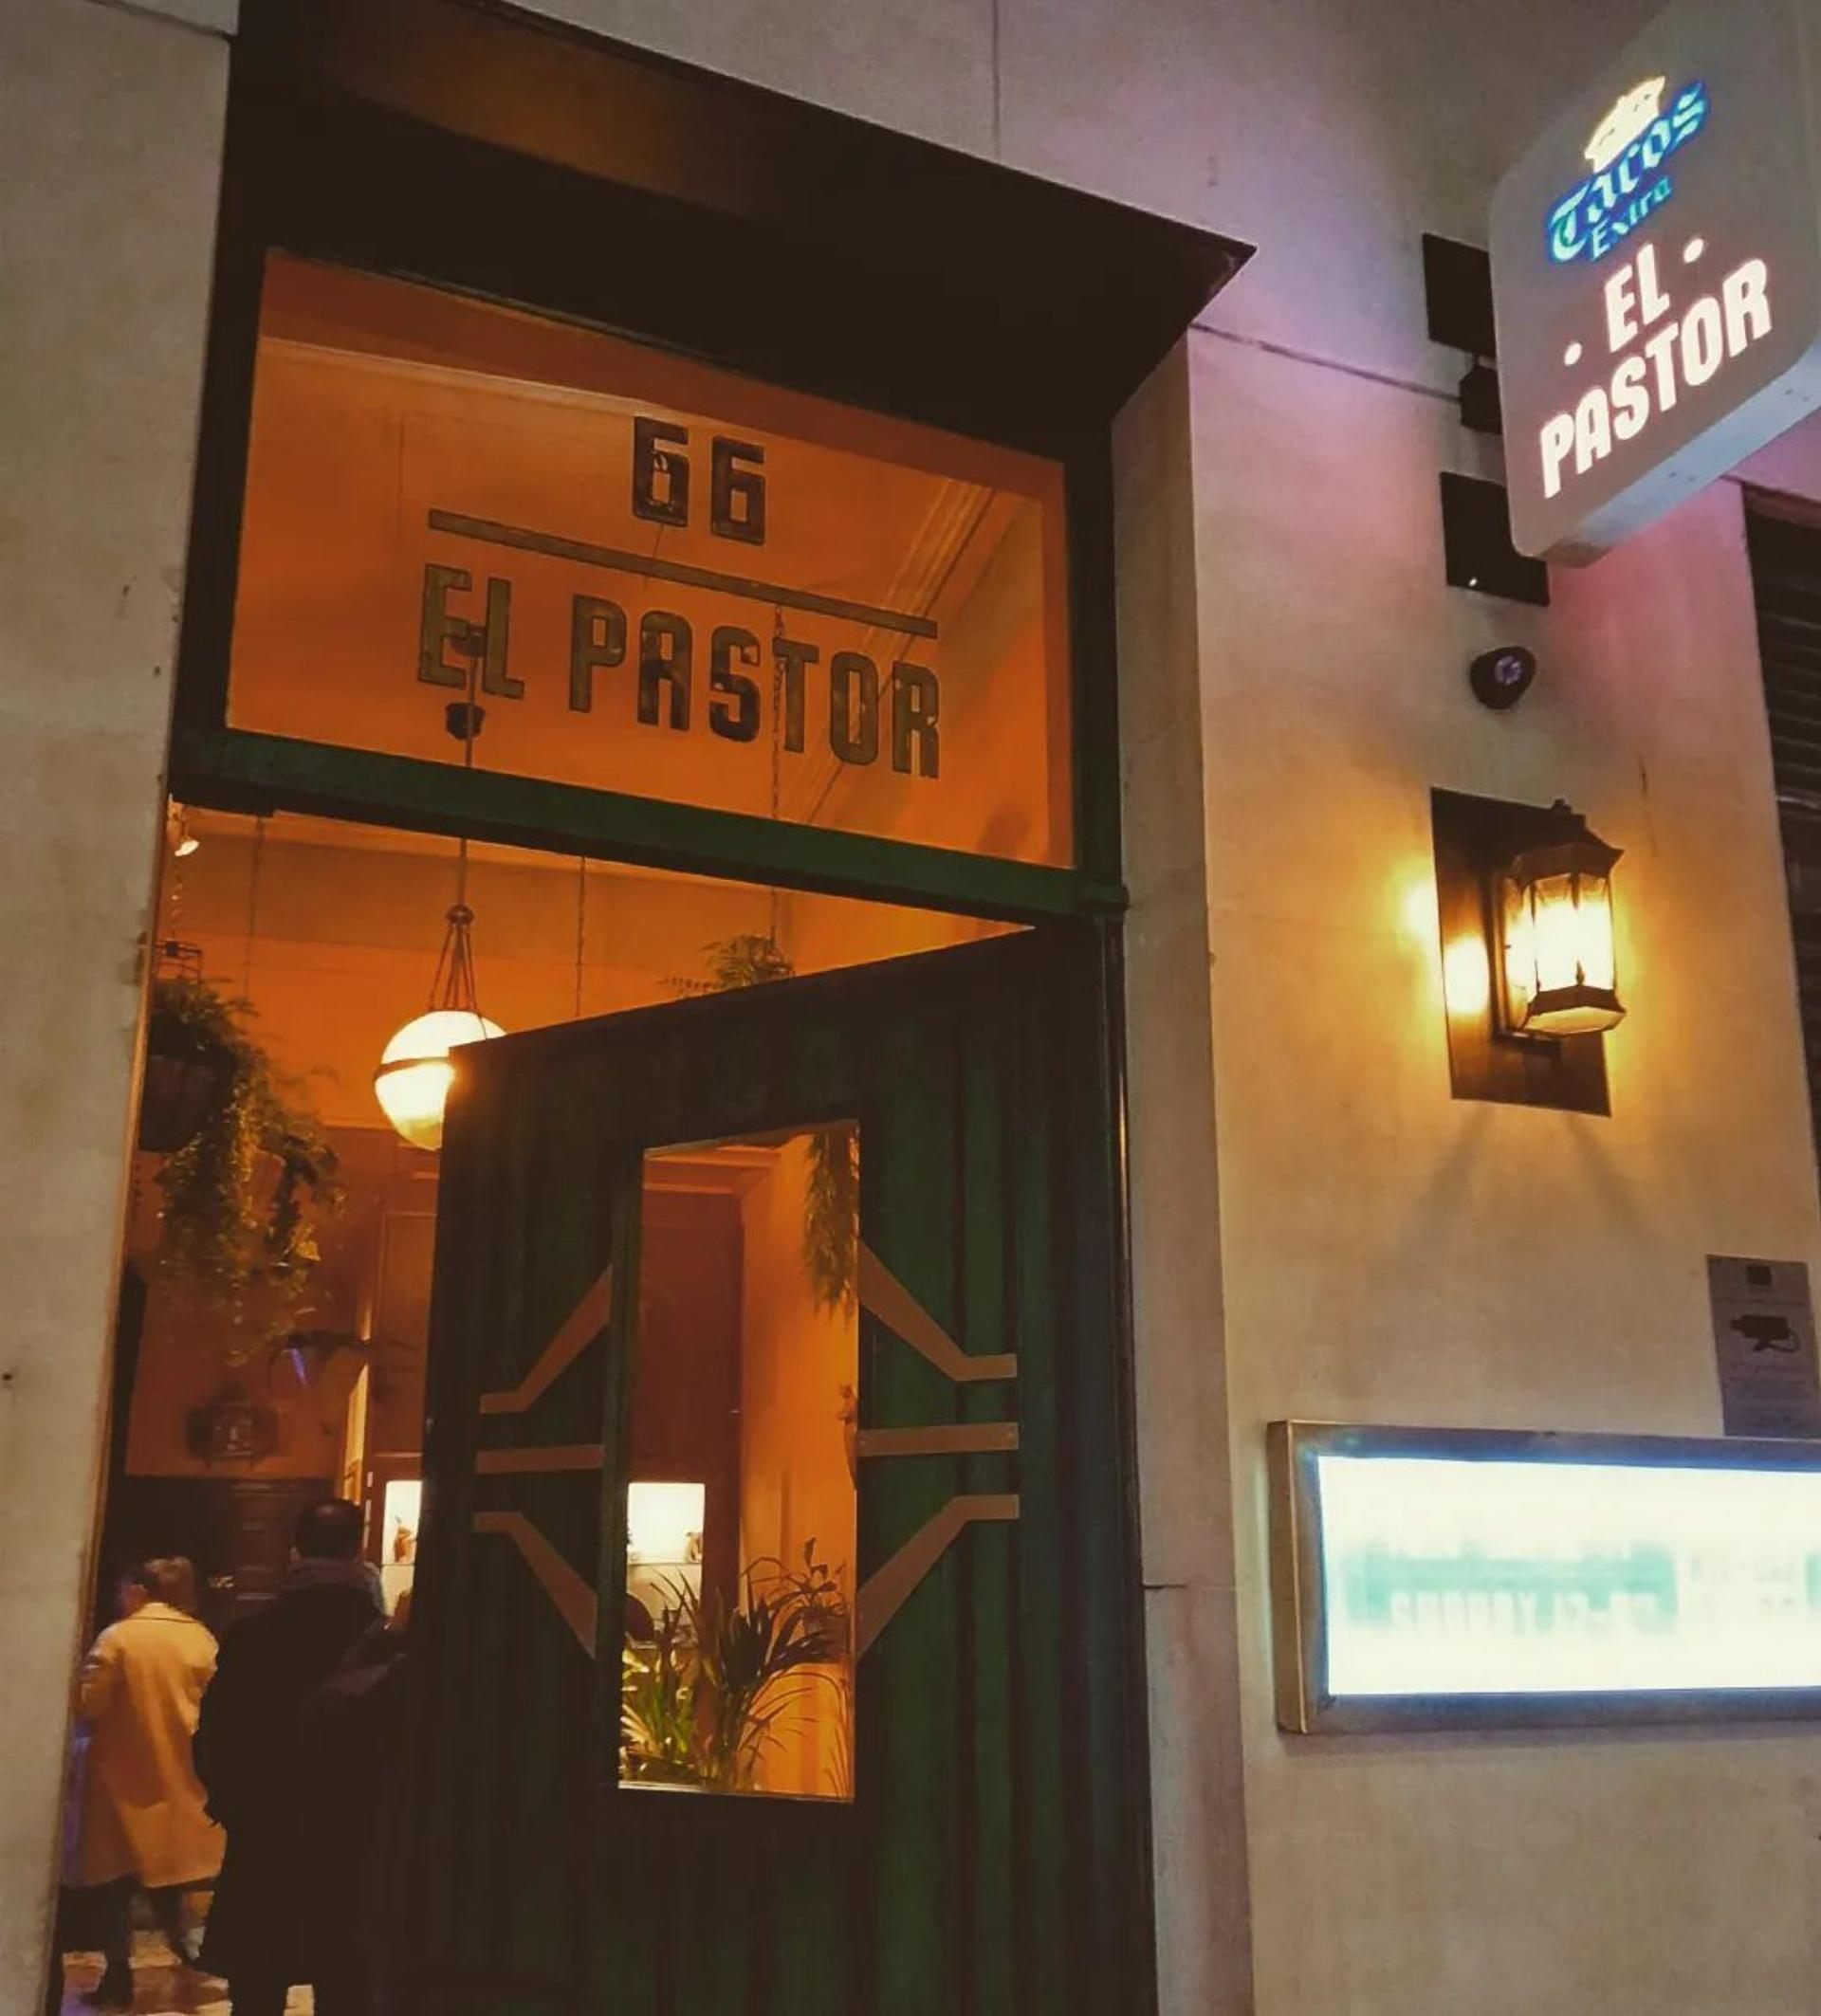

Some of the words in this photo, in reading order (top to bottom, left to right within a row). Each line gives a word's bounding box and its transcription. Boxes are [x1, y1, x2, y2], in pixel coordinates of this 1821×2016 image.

[1550, 82, 1707, 261] Tacos
[1540, 259, 1773, 500] PASTOR
[1605, 244, 1670, 354] EL
[633, 415, 765, 546] 66
[417, 564, 524, 700] EL
[569, 593, 940, 779] PASTOR
